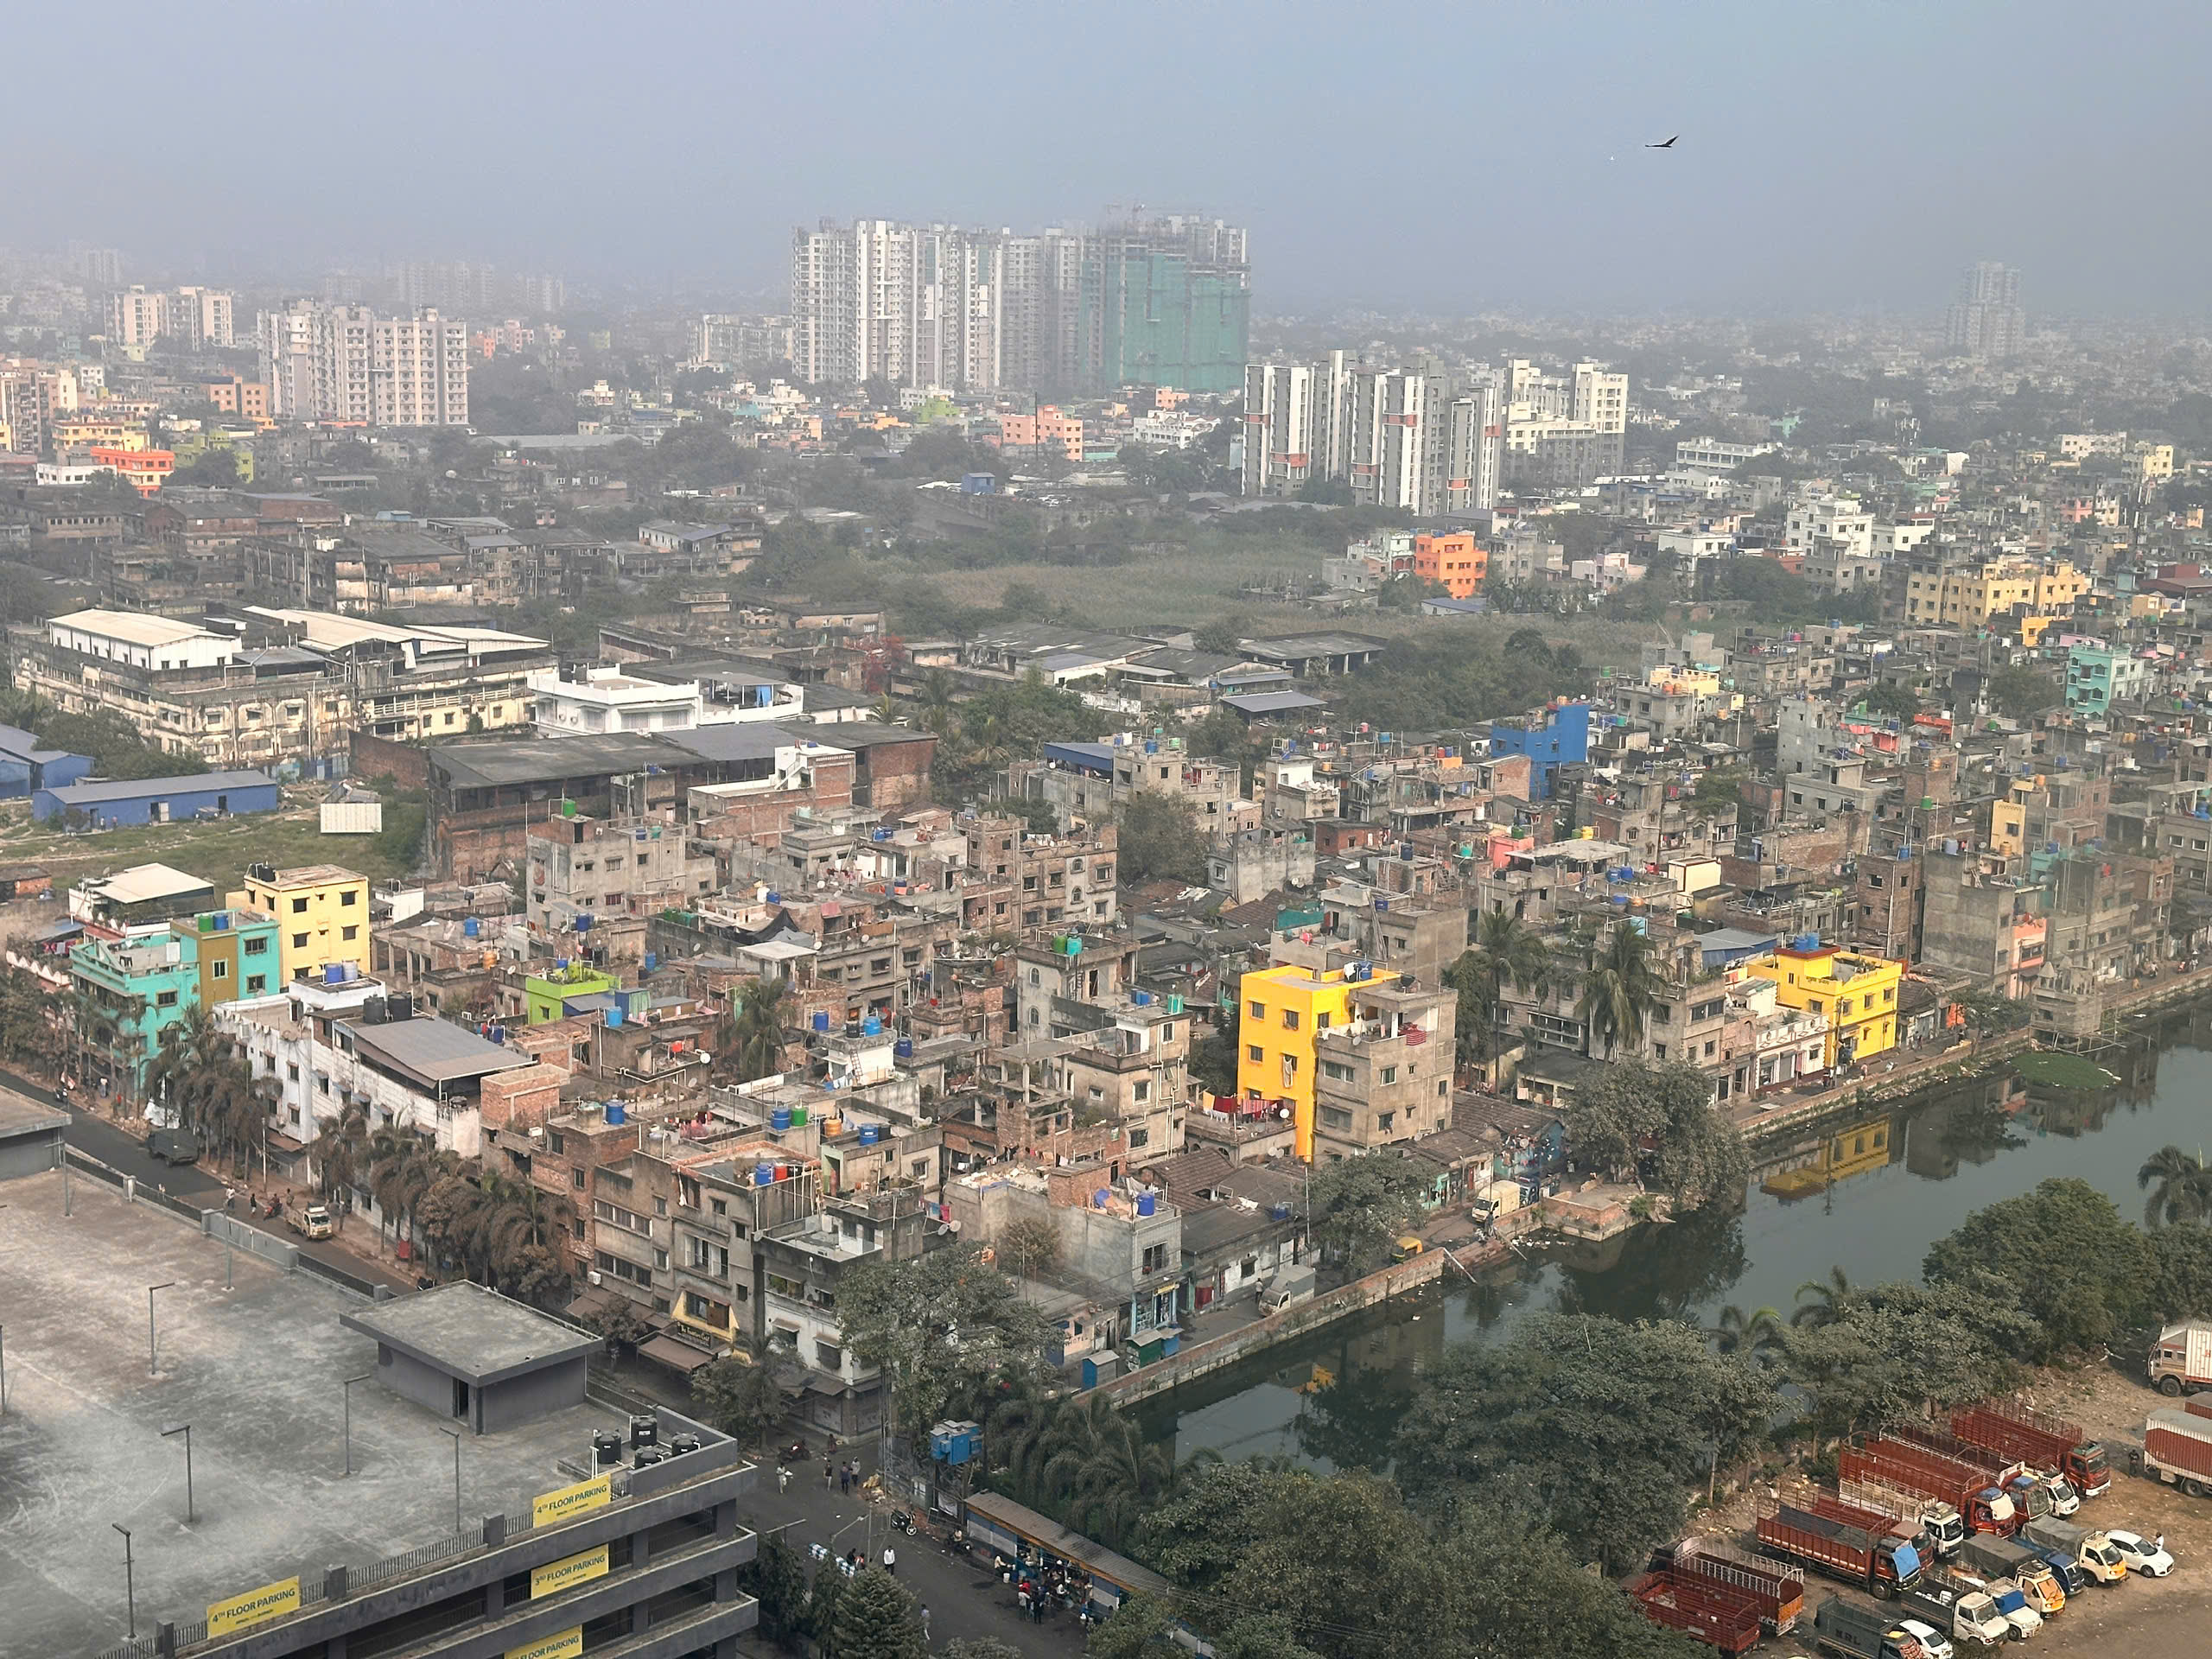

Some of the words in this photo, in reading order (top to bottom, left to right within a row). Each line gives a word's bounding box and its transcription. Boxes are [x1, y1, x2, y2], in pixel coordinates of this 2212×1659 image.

[549, 1496, 574, 1510] FLOOR
[575, 1484, 607, 1503] PARKING
[547, 1567, 572, 1581] FLOOR
[573, 1554, 606, 1573] PARKING
[226, 1601, 256, 1618] FLOOR
[257, 1587, 296, 1608] PARKING
[546, 1635, 579, 1654] PARKING
